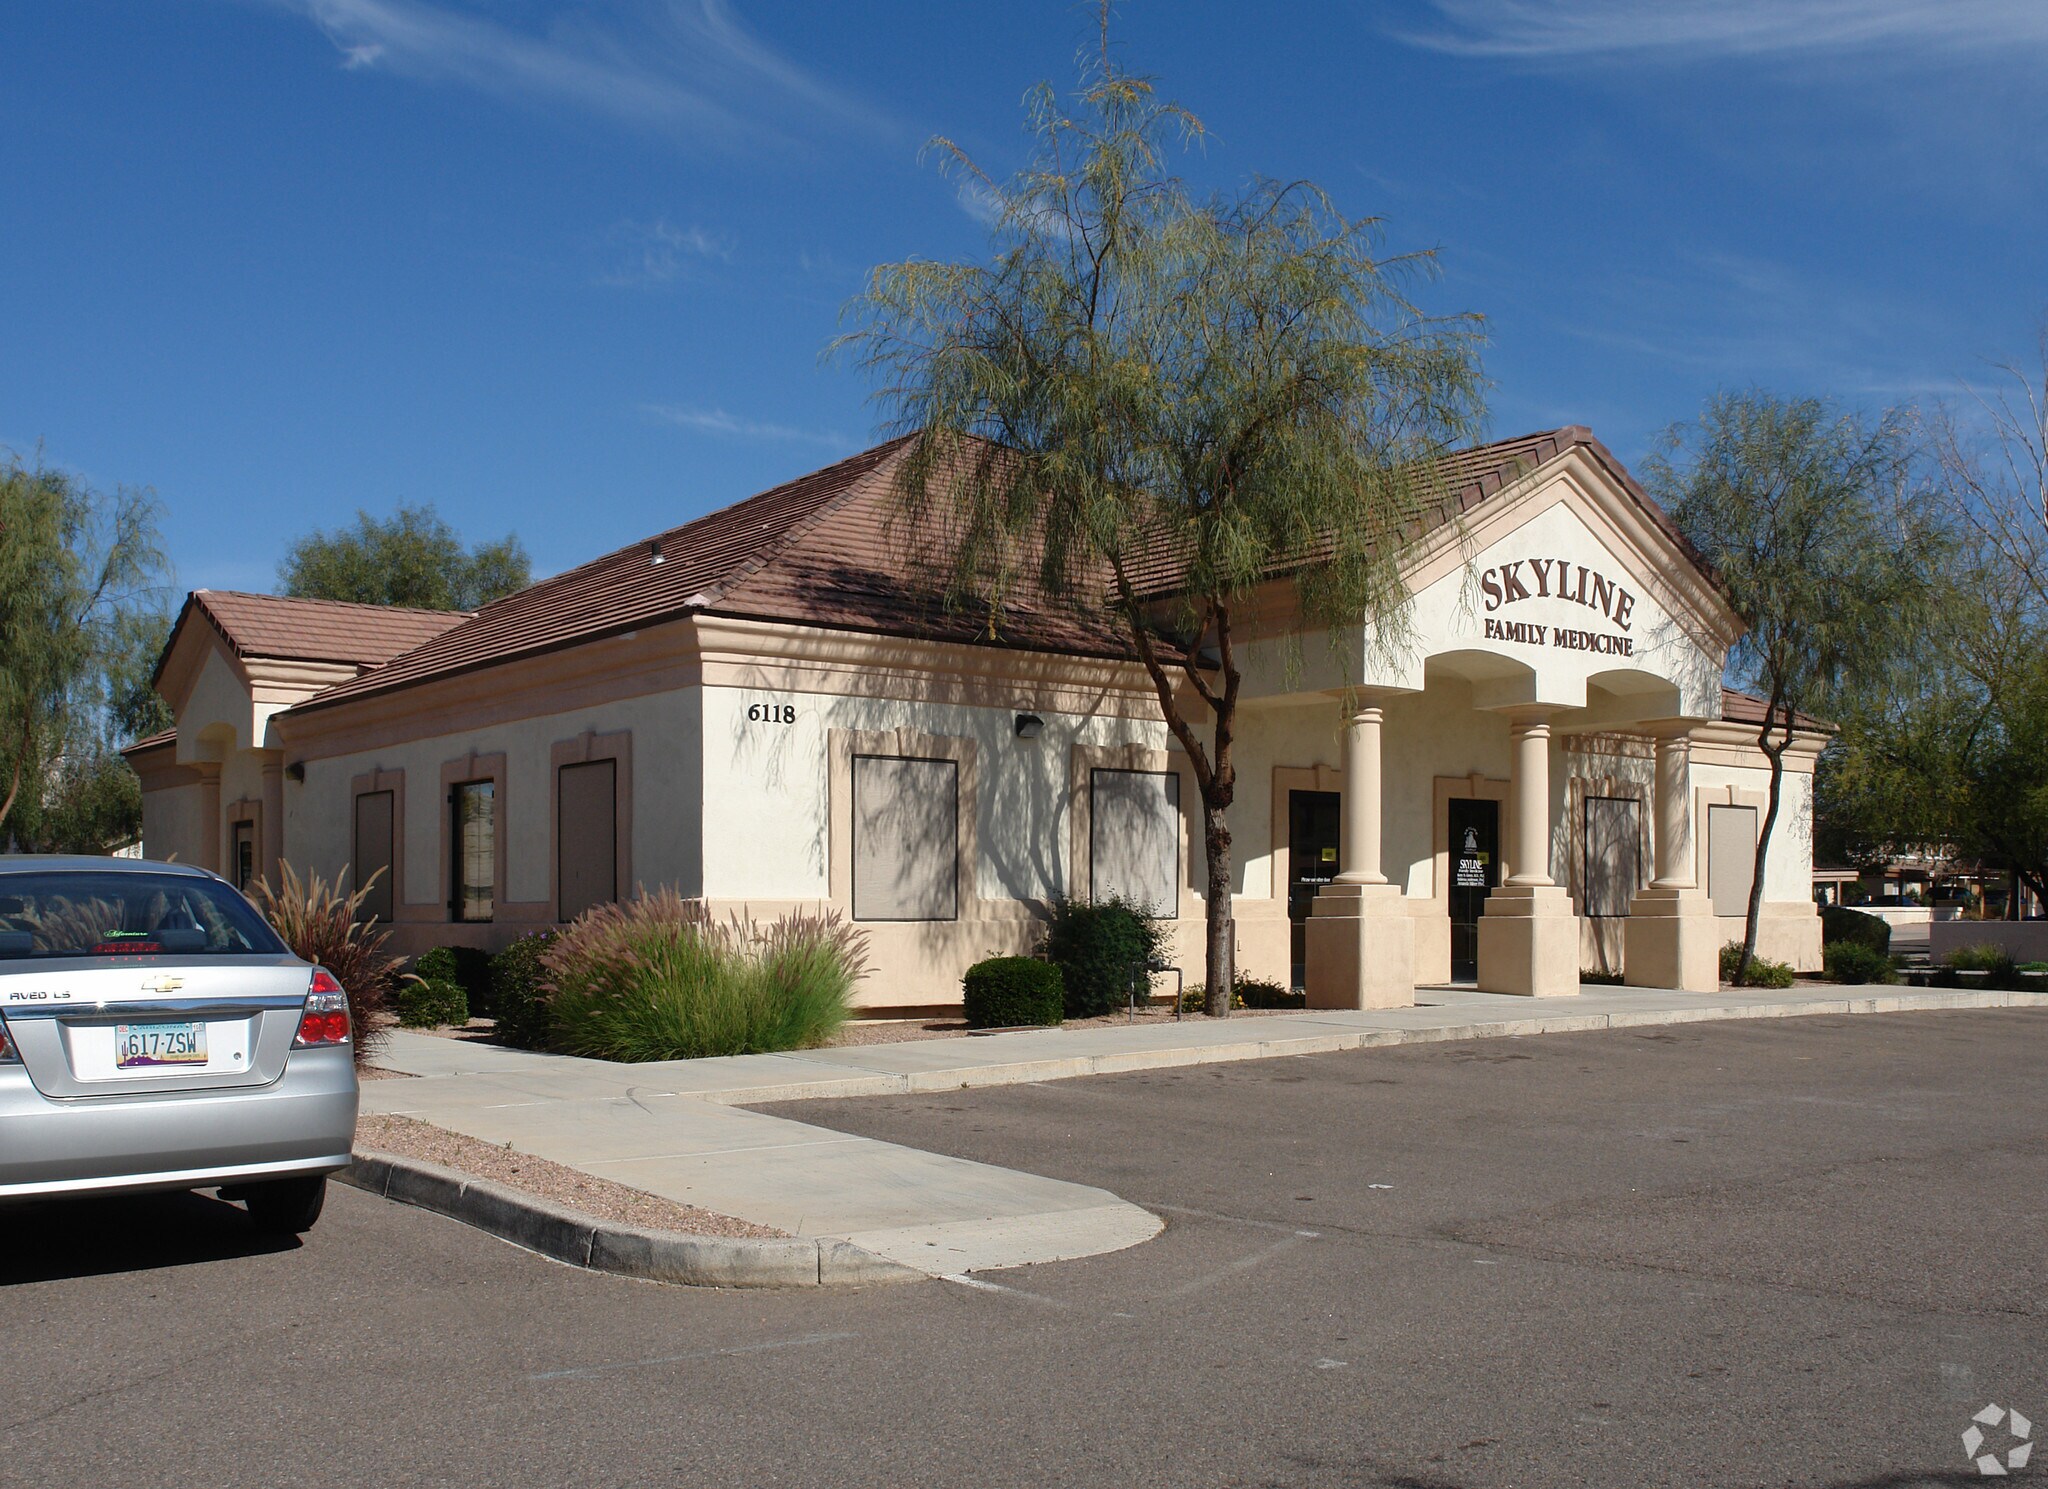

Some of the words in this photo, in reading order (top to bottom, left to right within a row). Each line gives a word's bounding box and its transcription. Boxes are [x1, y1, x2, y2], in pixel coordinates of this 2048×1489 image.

[1481, 558, 1636, 632] SKYLINE
[1484, 618, 1548, 645] FAMILY
[1553, 627, 1634, 657] MEDICINE
[748, 703, 796, 724] 6118
[1460, 858, 1482, 869] SKYLINE
[9, 991, 48, 1000] AVEO
[53, 990, 71, 999] LS
